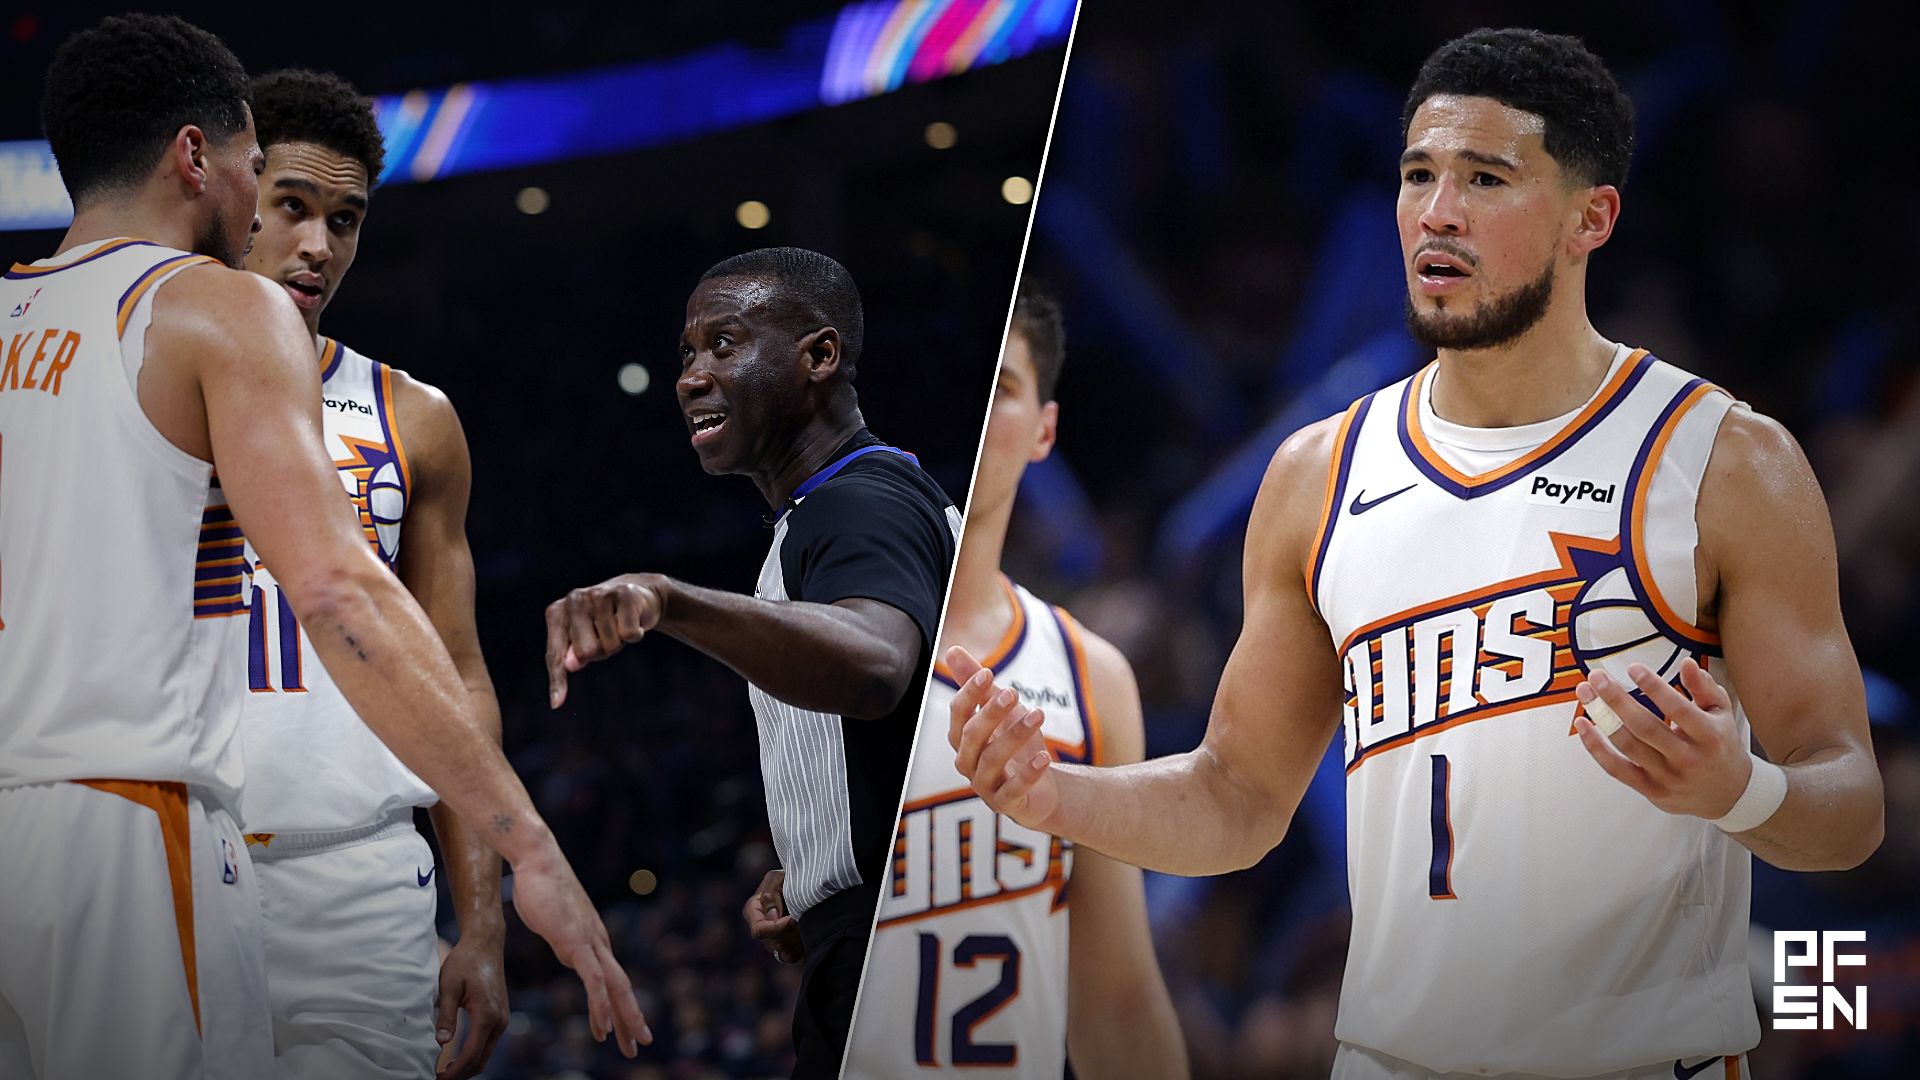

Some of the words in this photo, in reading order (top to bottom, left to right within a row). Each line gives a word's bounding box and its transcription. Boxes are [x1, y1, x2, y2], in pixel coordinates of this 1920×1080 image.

[0, 328, 82, 397] KER
[1531, 476, 1616, 504] PayPal
[248, 584, 309, 693] 11
[1429, 754, 1458, 900] 1
[915, 931, 1022, 1068] 12
